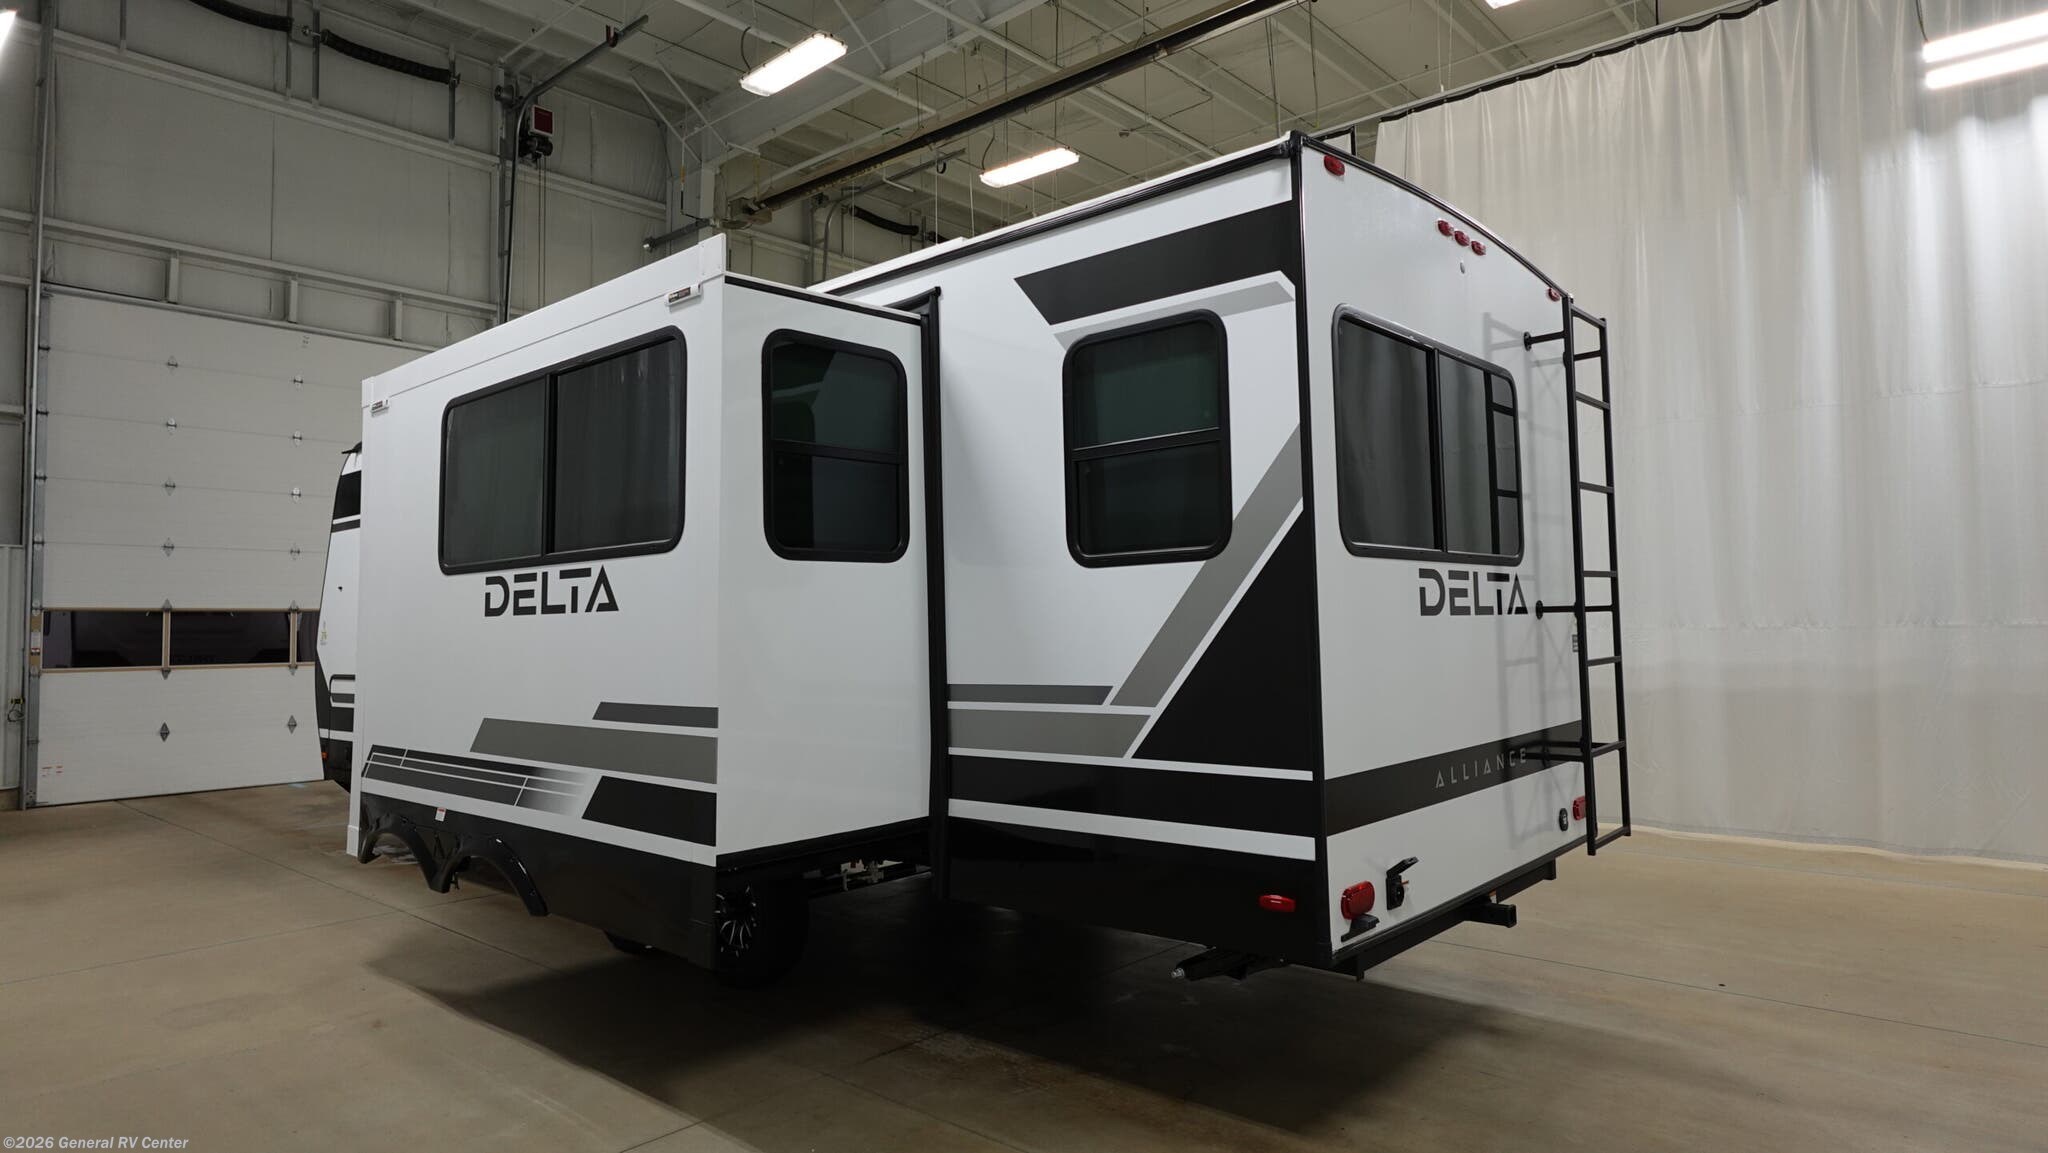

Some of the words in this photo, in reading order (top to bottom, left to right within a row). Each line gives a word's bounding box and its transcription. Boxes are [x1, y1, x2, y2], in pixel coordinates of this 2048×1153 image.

[484, 564, 619, 617] DELTA
[1419, 568, 1528, 616] DELTA
[1435, 747, 1527, 789] ALLIANCE
